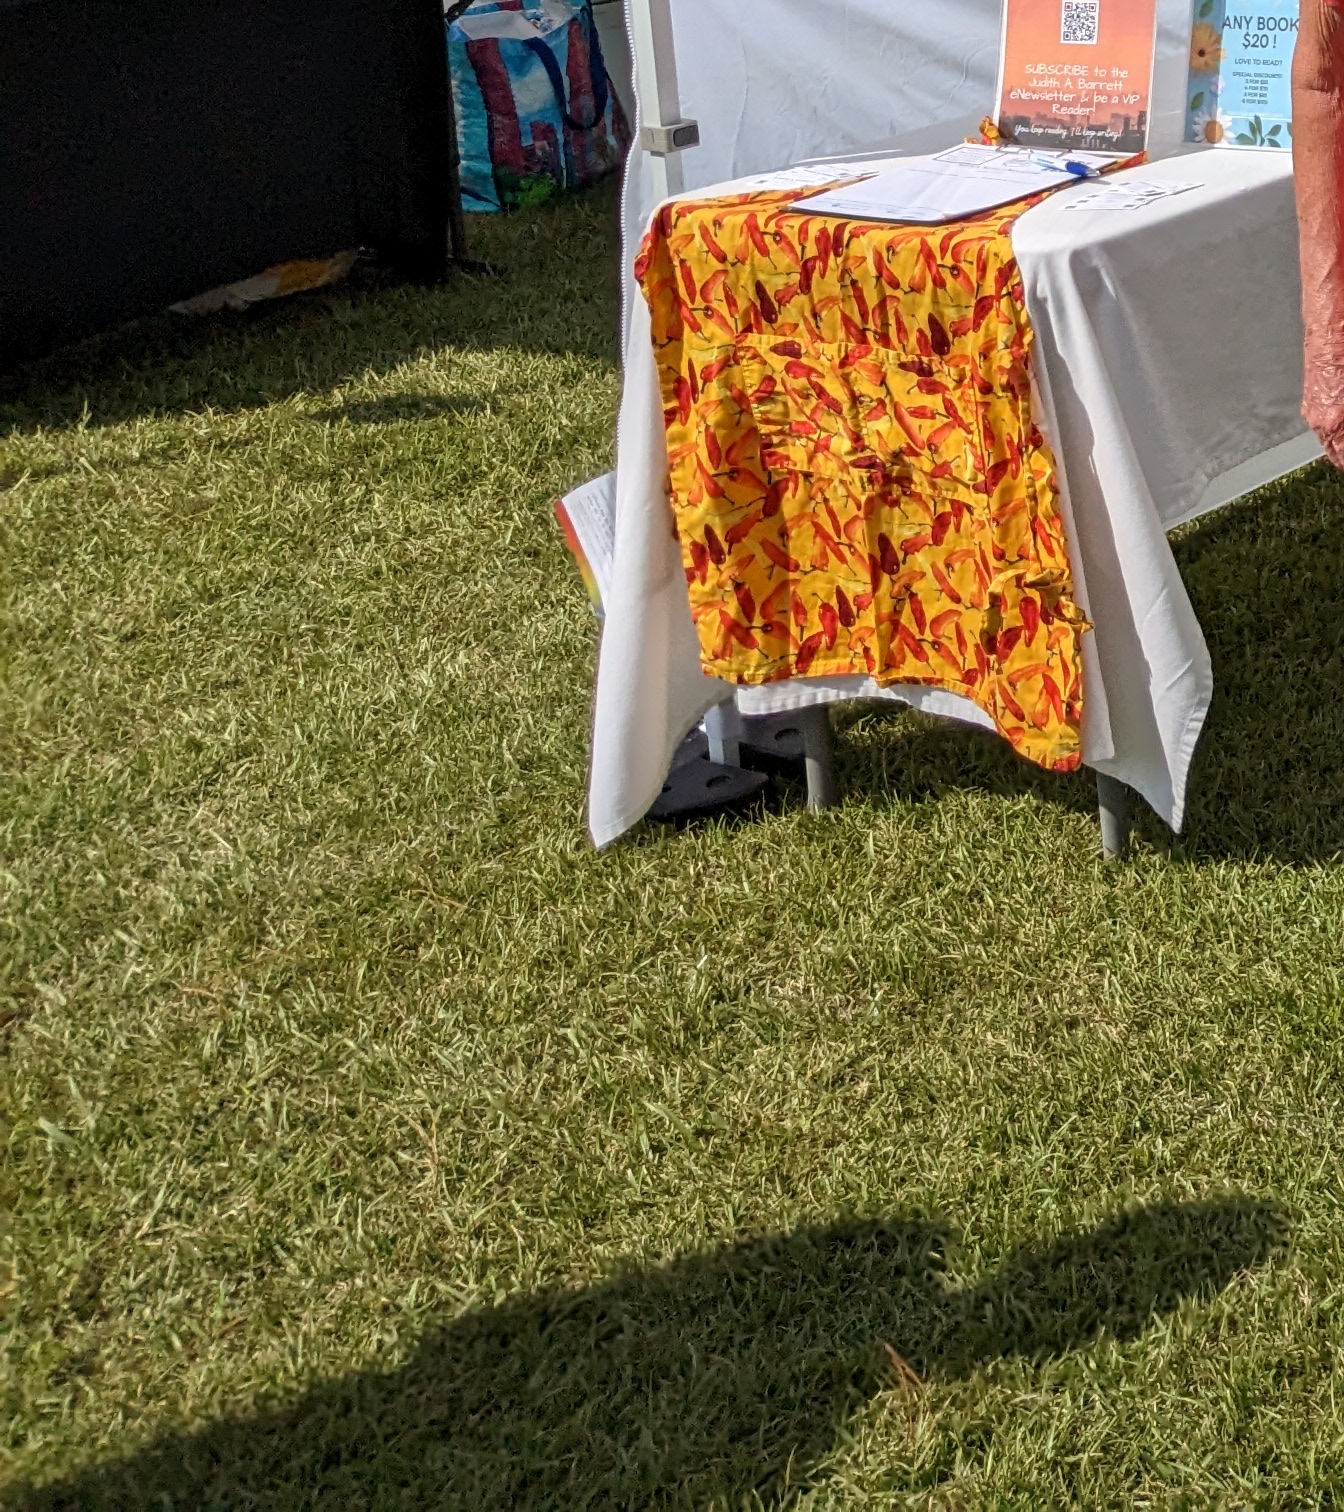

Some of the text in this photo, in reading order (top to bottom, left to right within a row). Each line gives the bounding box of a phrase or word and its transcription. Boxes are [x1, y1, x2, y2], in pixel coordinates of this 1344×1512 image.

[1222, 15, 1300, 32] ANY BOOK
[1242, 32, 1269, 49] $20
[1026, 64, 1128, 78] SUBSCRIBE to the
[1029, 76, 1123, 90] Judith A Barrett
[1010, 89, 1076, 102] eNewsletter
[1093, 91, 1108, 103] be
[1123, 95, 1140, 104] VIP
[1052, 103, 1095, 115] Reader!
